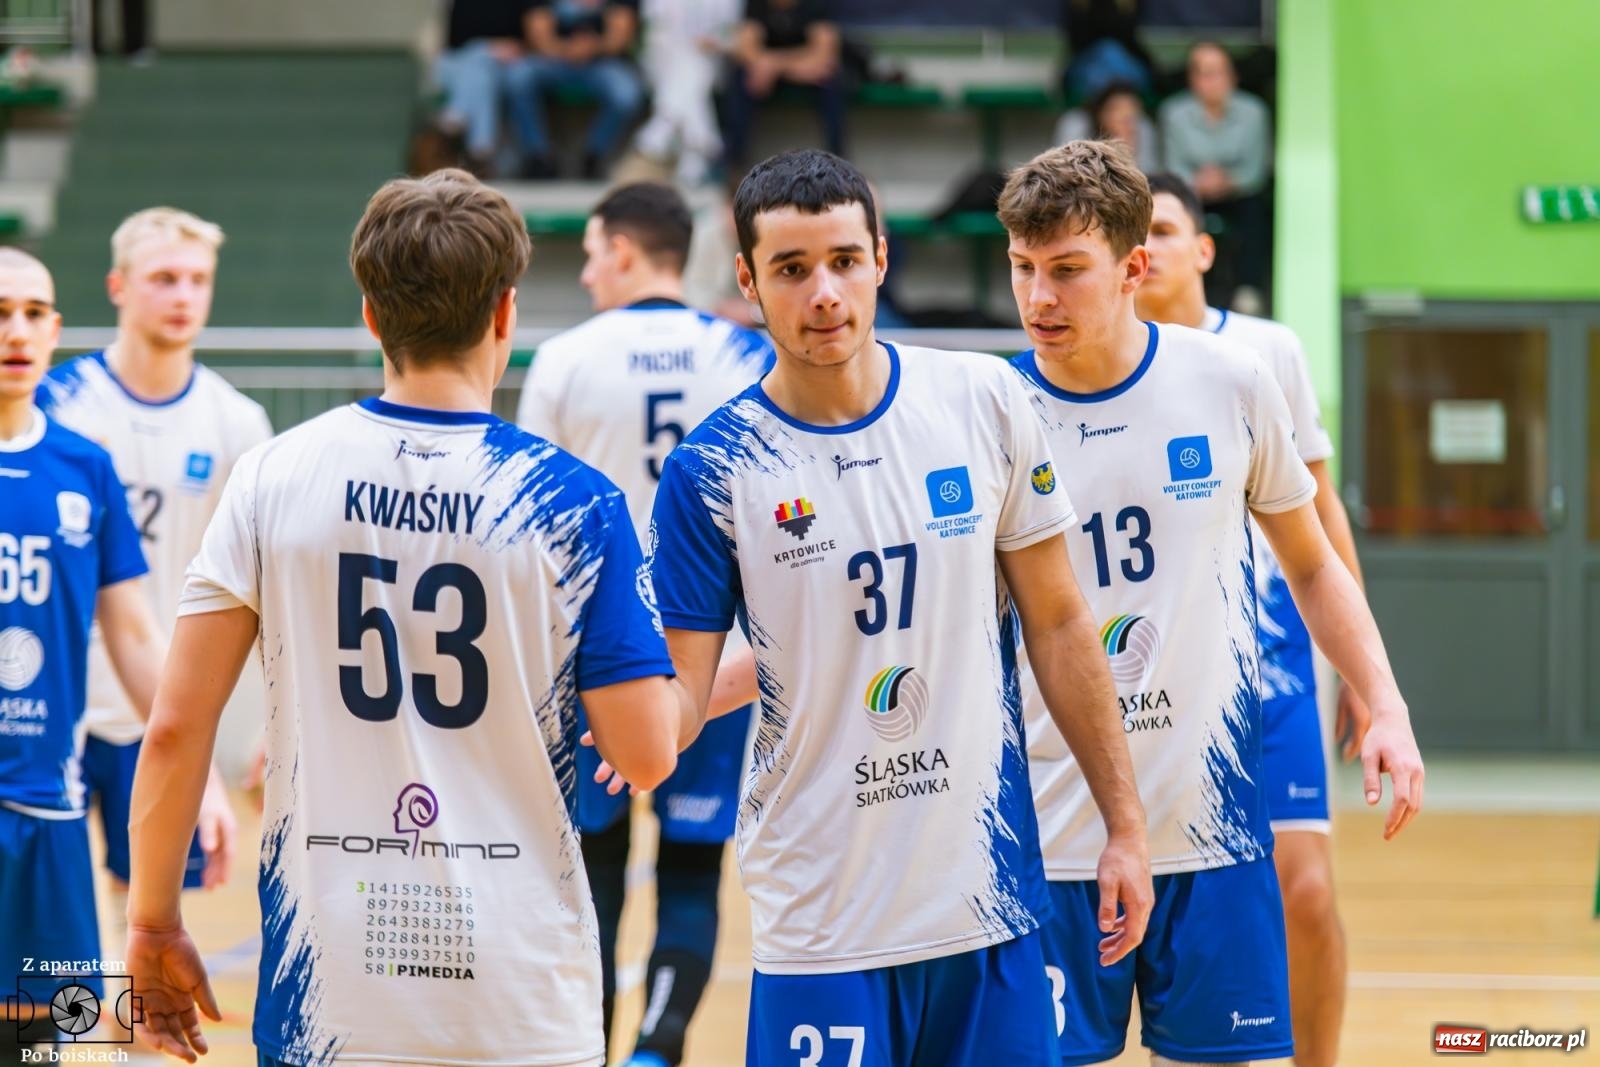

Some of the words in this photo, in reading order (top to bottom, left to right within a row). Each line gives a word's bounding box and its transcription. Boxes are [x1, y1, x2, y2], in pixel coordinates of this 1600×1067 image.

[645, 391, 686, 482] 5
[345, 480, 484, 534] KWAŚNY
[1163, 483, 1190, 494] VOLLEY
[1191, 480, 1222, 491] CONCEPT
[1176, 490, 1212, 501] KATOWICE
[925, 519, 953, 531] VOLLEY
[954, 514, 983, 527] CONCEPT
[939, 526, 976, 539] KATOWICE
[774, 539, 837, 564] KATOWICE
[1082, 505, 1155, 588] 13
[0, 532, 51, 606] 65
[847, 542, 918, 636] 37
[338, 552, 488, 729] 53
[855, 748, 950, 785] ŚLĄSKA
[856, 777, 950, 808] SIATKÓWKA
[790, 1024, 865, 1067] 37
